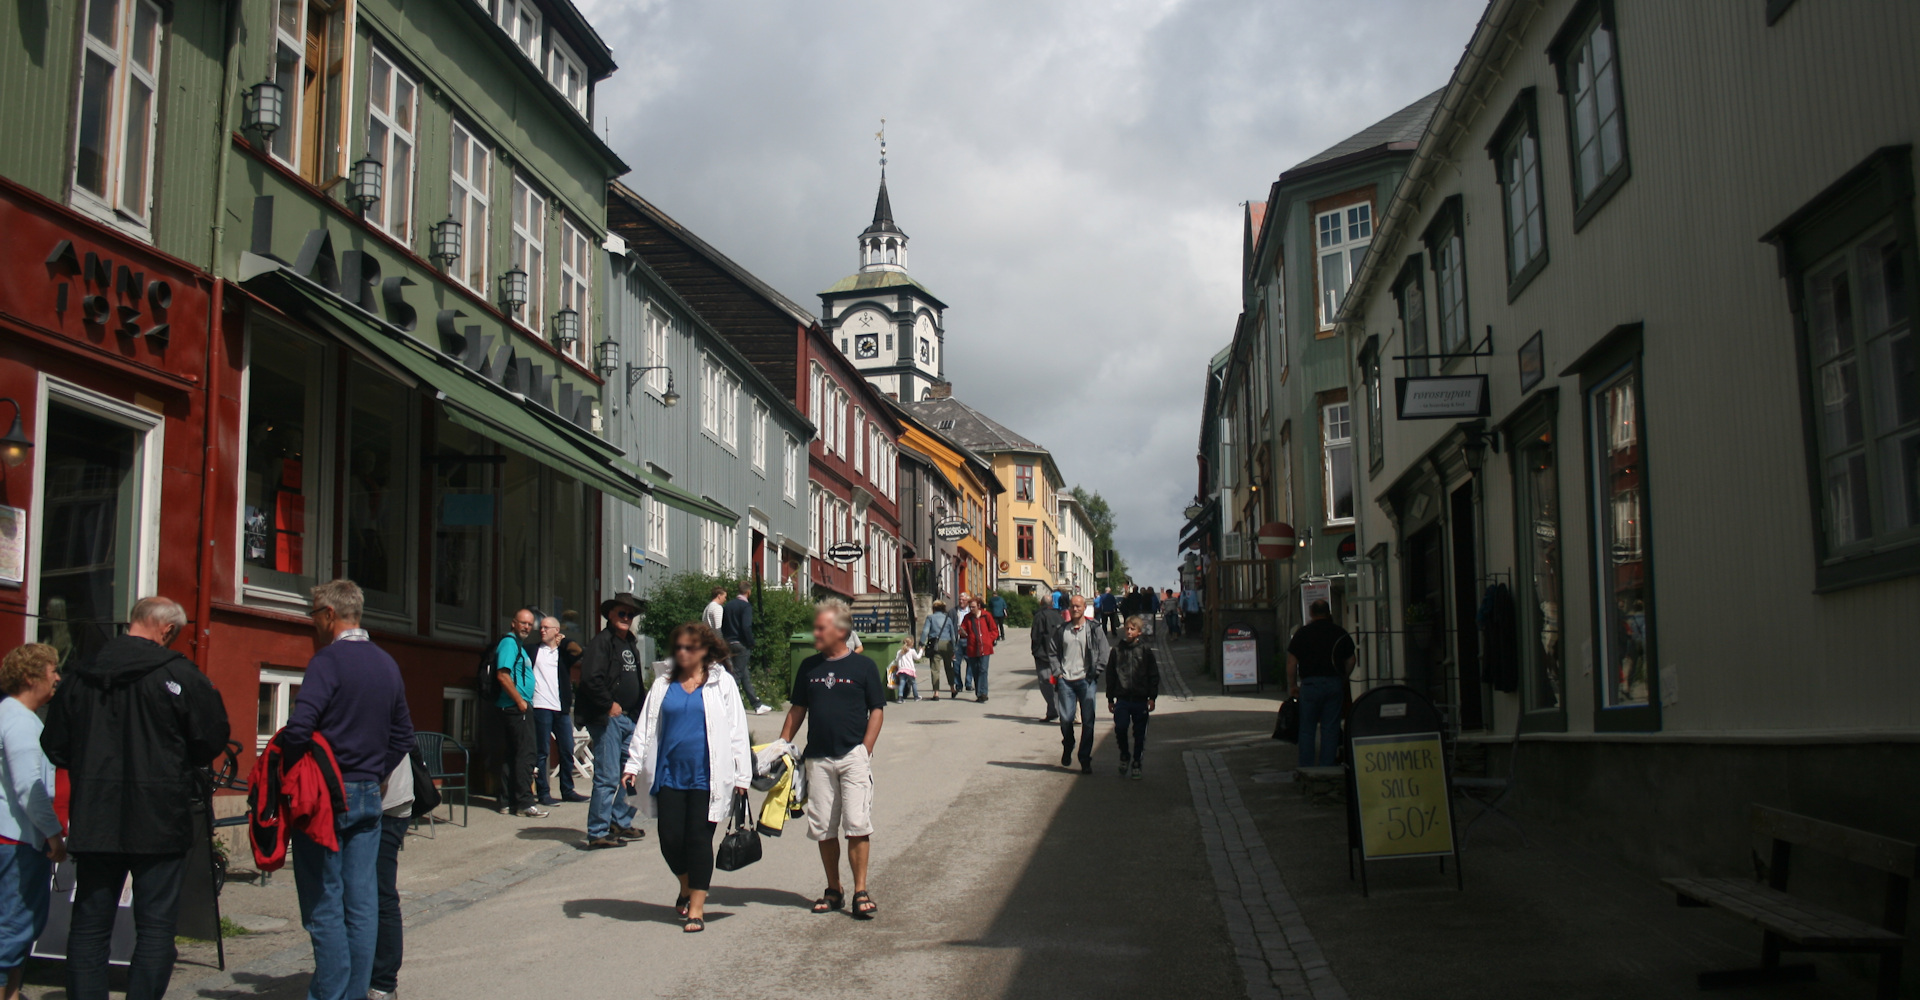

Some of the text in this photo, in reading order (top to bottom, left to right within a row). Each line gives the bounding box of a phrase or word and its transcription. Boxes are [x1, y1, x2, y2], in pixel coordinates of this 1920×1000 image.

[44, 240, 172, 309] ANNO
[250, 195, 418, 332] LARS
[56, 282, 170, 349] 1934
[1381, 777, 1420, 799] SALG
[1378, 805, 1440, 841] -50%
